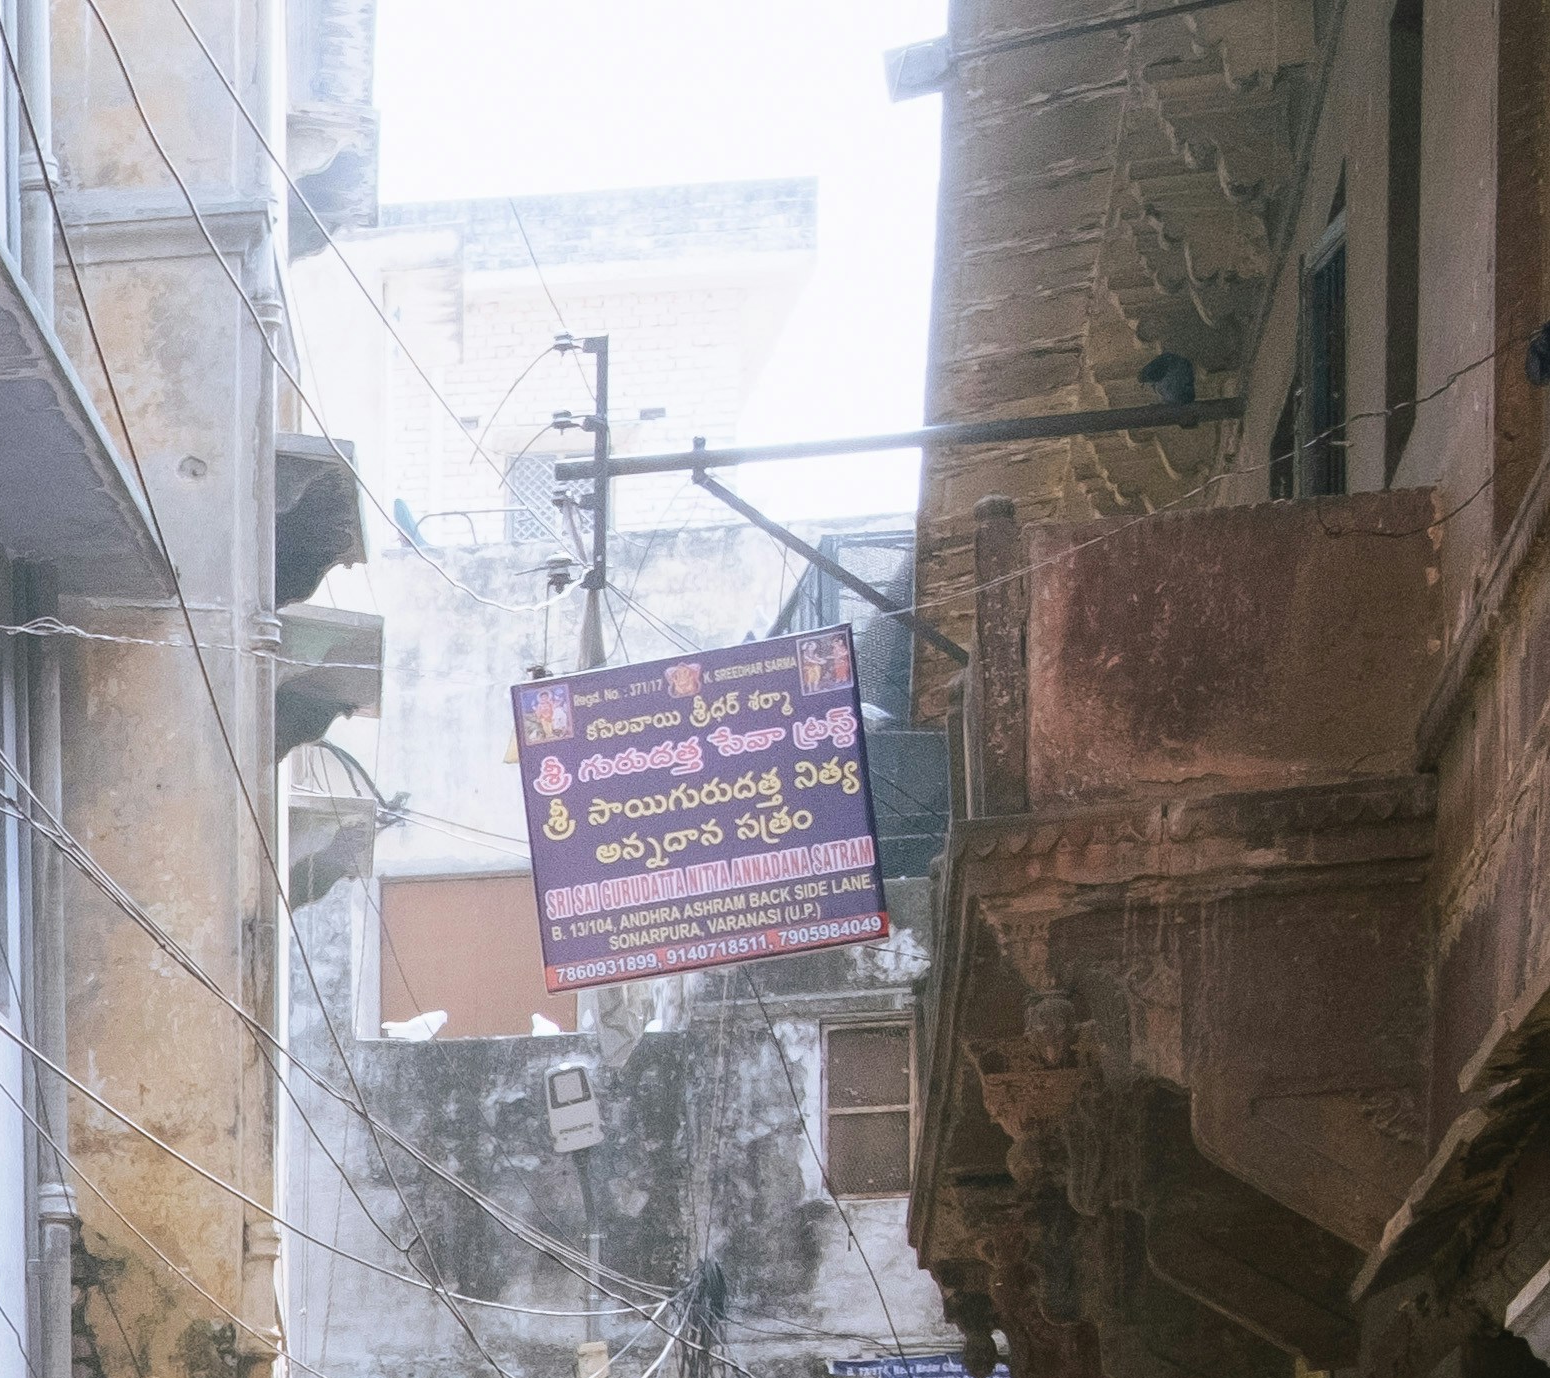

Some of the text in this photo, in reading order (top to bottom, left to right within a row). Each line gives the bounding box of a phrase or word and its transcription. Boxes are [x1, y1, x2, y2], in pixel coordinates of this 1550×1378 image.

[714, 663, 763, 681] SREEDHAR
[764, 656, 797, 674] SARMA
[534, 705, 857, 796] శ్రీ గురుదత్త సేవా ట్రస్ట్
[543, 799, 575, 840] శ్రీ
[794, 755, 860, 795] నిత్య
[595, 807, 813, 869] అన్నదాన సత్రం
[545, 835, 875, 921] SRI SAI GURUDATTA NITYA ANNADANA SATRAM
[552, 872, 876, 941] B. 13/104, ANDHRA ASHRAM BACK SIDE LANE,
[555, 915, 882, 985] 7860931899, 9140718511, 7905984049
[609, 902, 822, 951] SONARPURA, VARANASI (U.P.)
